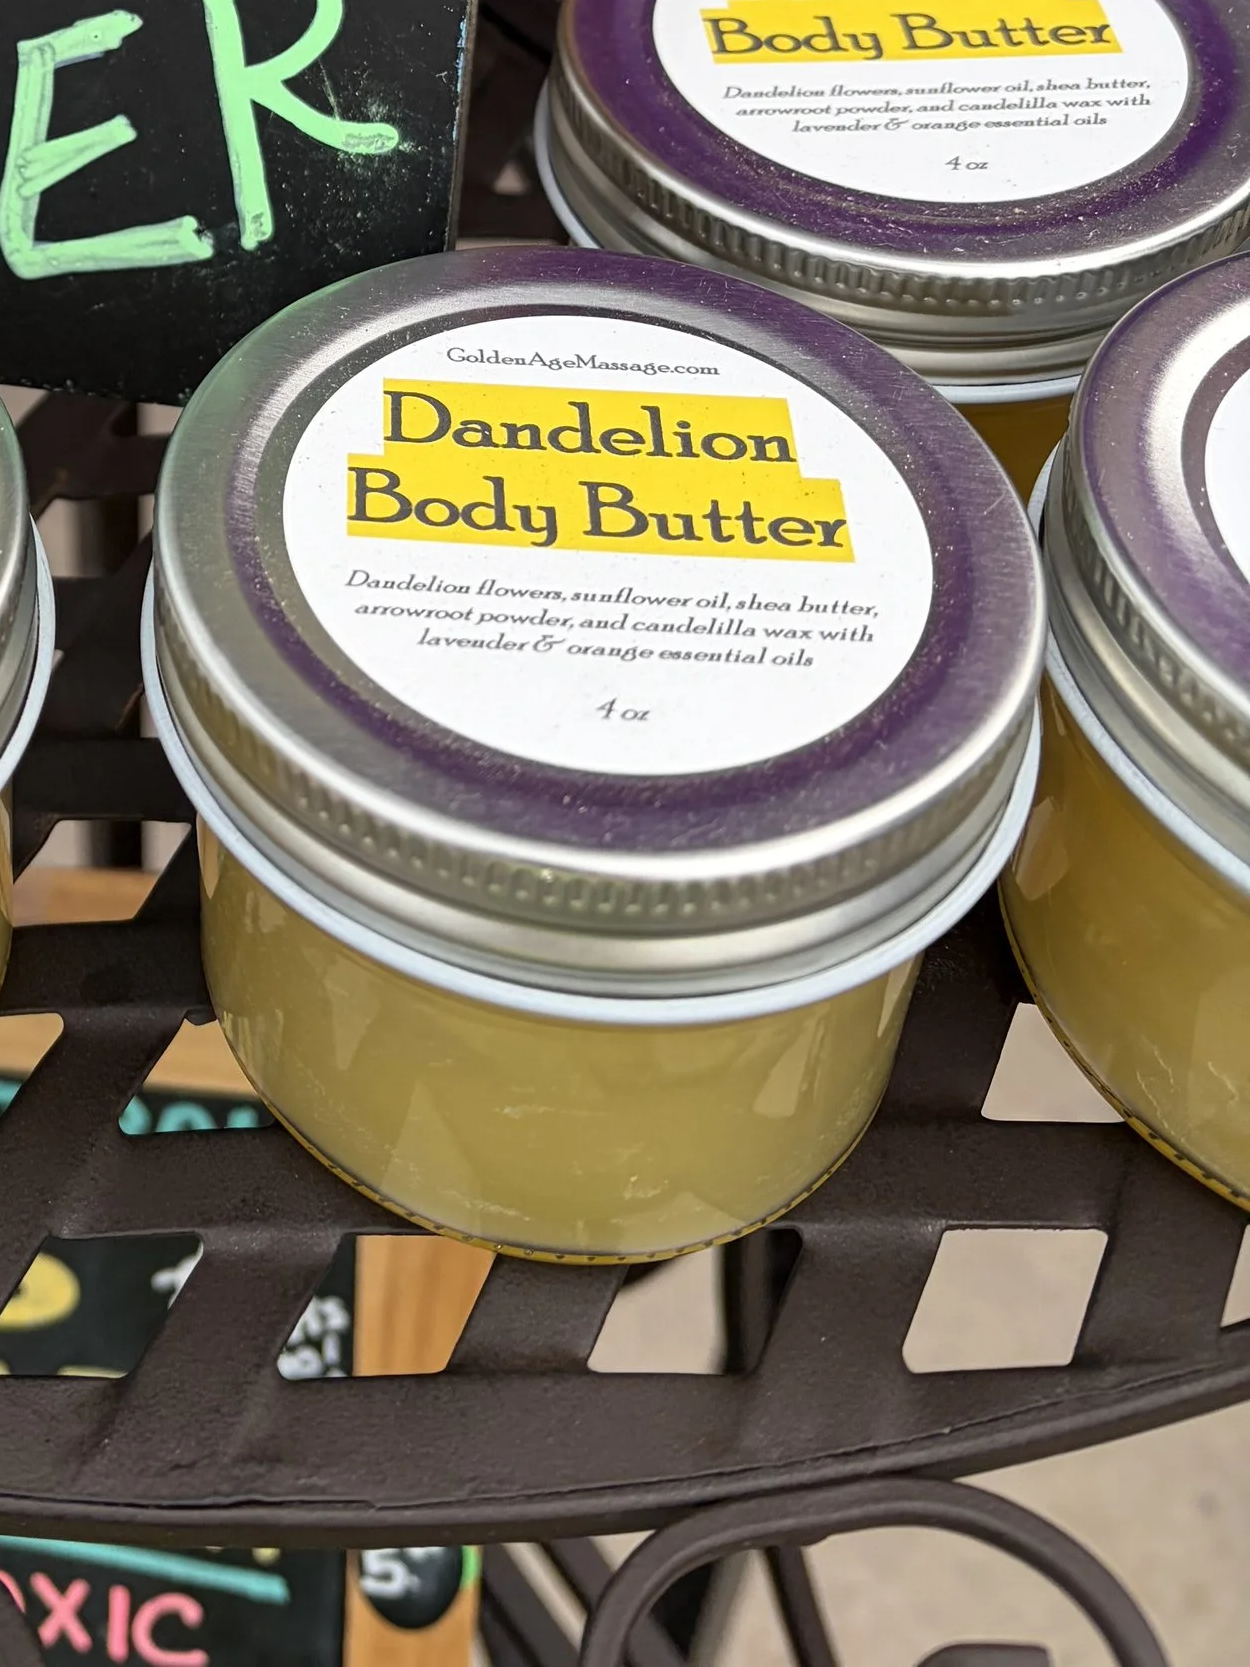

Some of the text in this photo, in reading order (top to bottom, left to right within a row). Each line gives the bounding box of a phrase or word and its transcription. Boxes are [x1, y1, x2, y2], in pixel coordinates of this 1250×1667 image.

[703, 11, 1111, 61] Body Butter
[722, 84, 826, 100] Dandelion
[829, 83, 903, 98] flowers,
[904, 81, 1001, 96] sunflower
[1036, 78, 1081, 92] shea
[1084, 76, 1152, 91] butter,
[735, 93, 1151, 118] arrowroot powder, and candelilla wax with
[791, 112, 1108, 133] lavender & orange essential oils
[945, 155, 989, 171] 4 oz
[445, 345, 721, 378] GoldenAgeMassage.com
[382, 388, 799, 465] Dandelion
[347, 464, 848, 550] Body Butter
[344, 568, 880, 619] Dandelion flowers, sunflower oil, shea butter,
[354, 603, 875, 643] arrowroot powder, and candelilla wax with
[416, 627, 815, 668] lavender & orange essential oils
[595, 696, 652, 722] 4 oz
